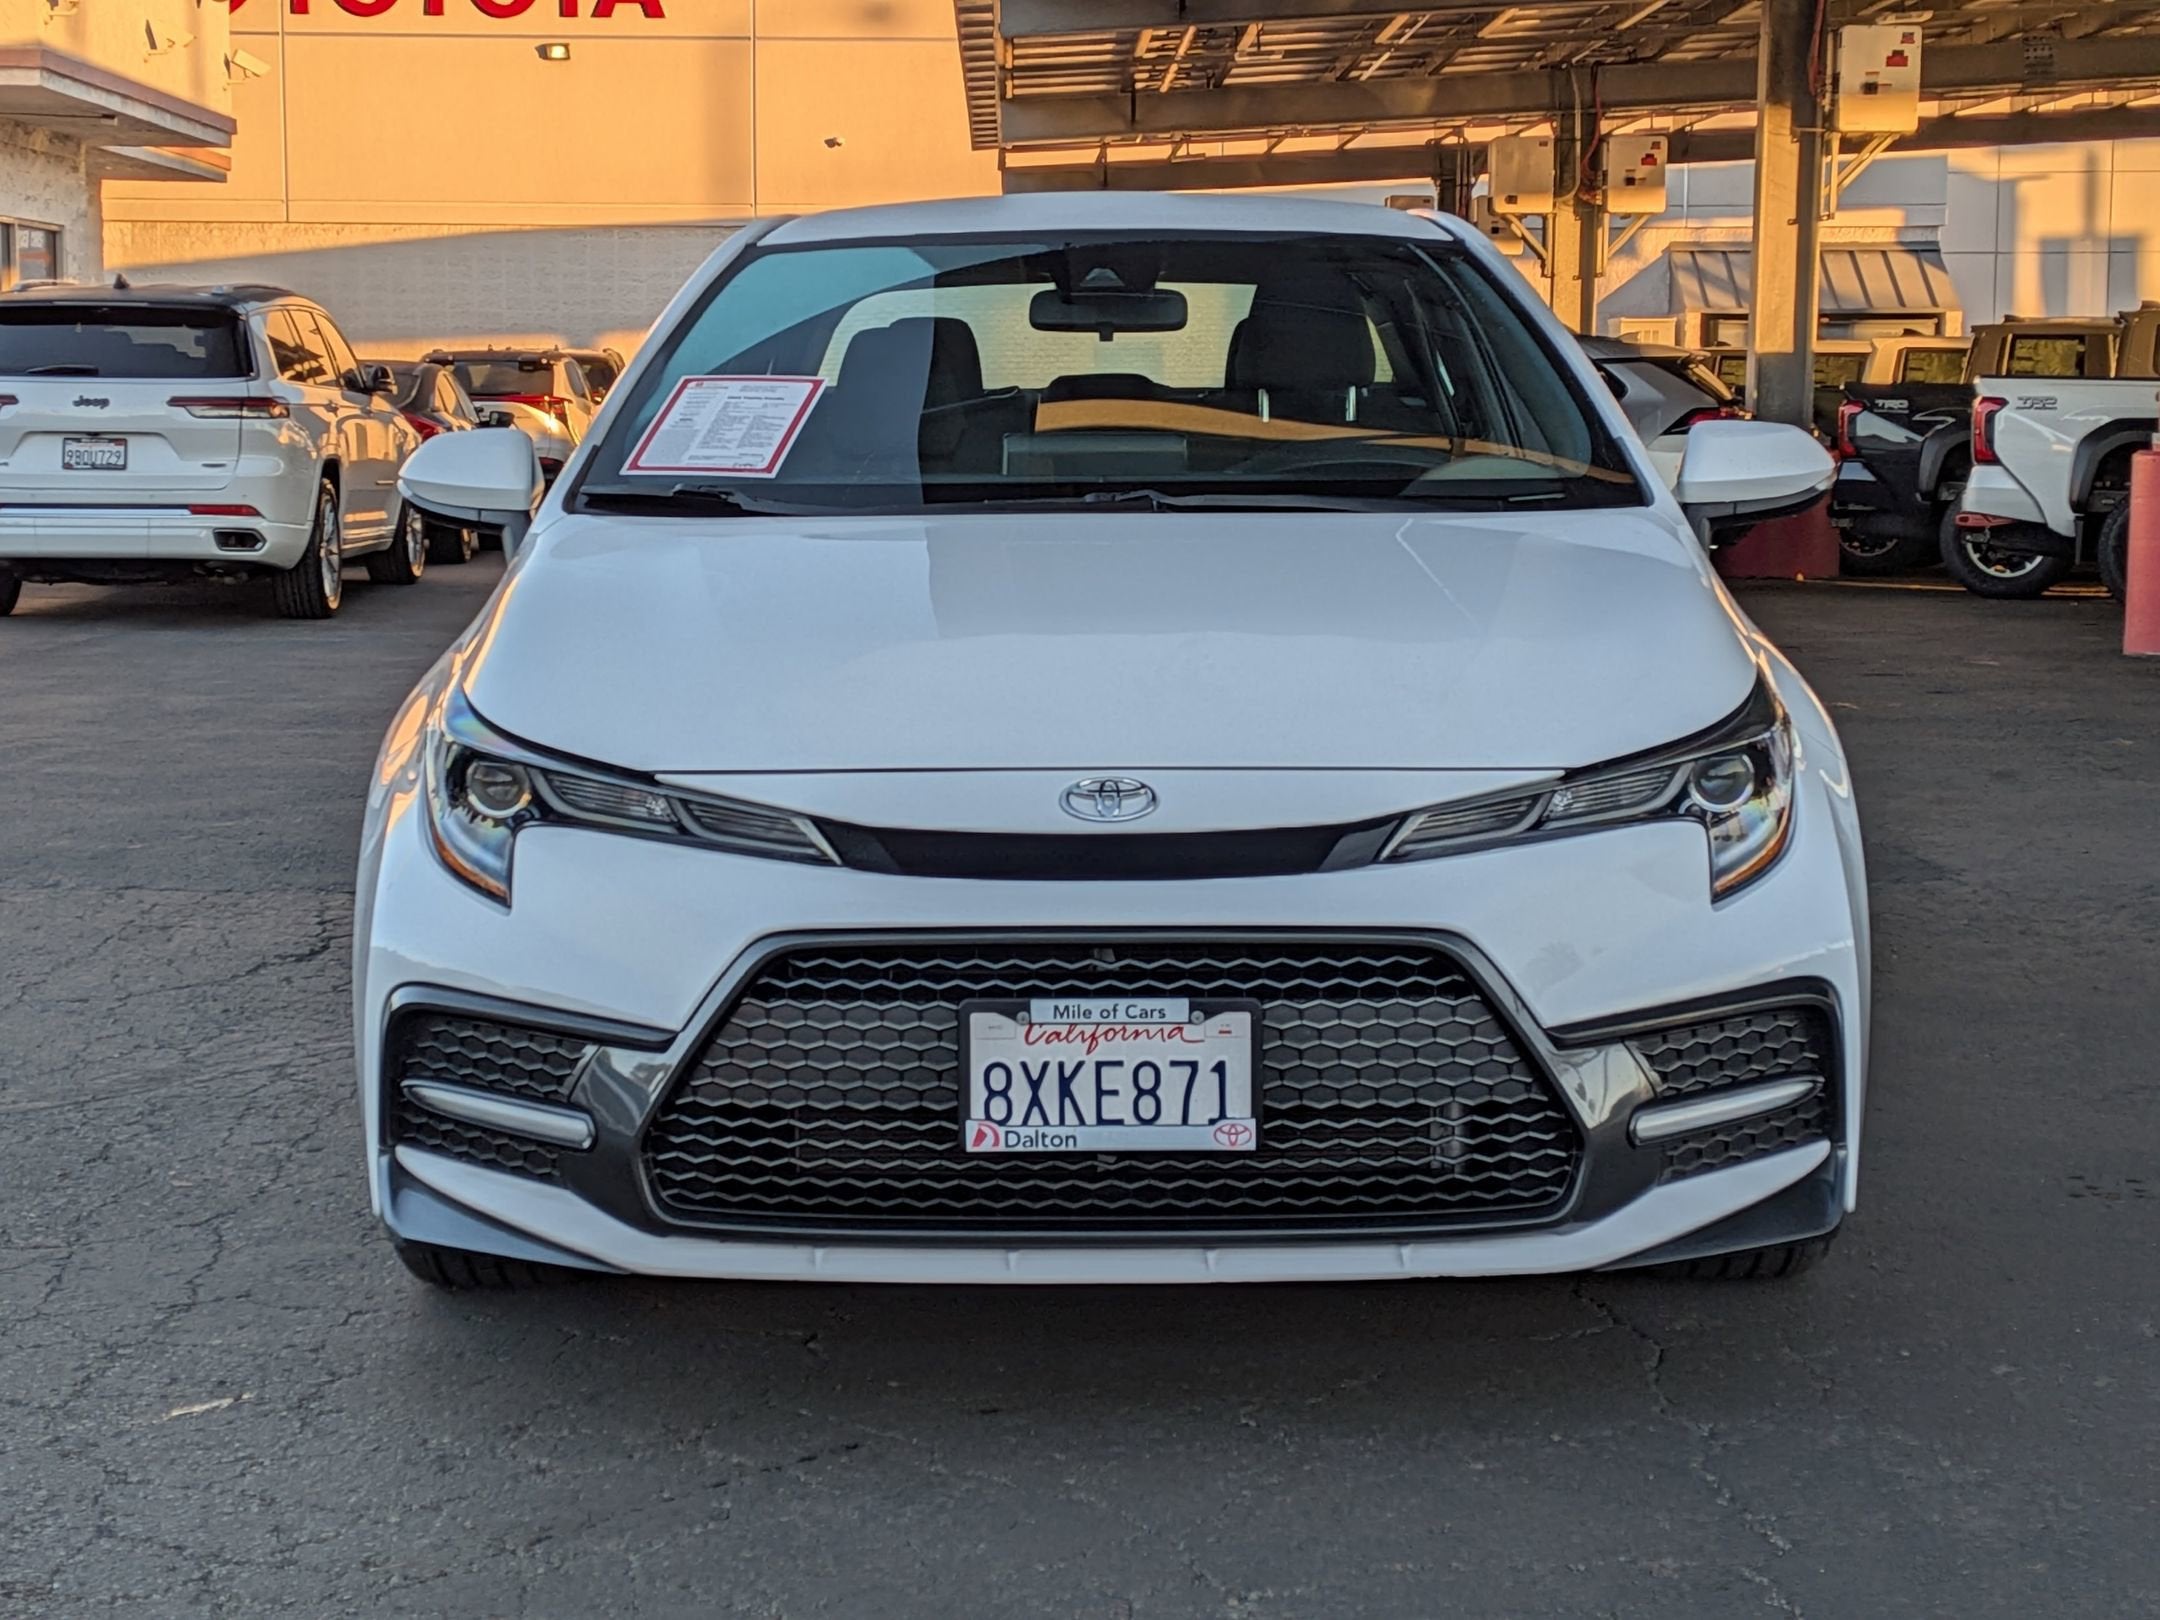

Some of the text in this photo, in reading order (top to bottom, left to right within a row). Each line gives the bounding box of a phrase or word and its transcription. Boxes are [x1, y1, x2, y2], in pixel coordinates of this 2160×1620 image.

[72, 395, 110, 410] Jeep
[1874, 399, 1909, 409] TRD
[1053, 1004, 1167, 1020] Mile of Cars
[1024, 1023, 1205, 1056] California
[983, 1060, 1227, 1126] 8XKE871
[1005, 1130, 1078, 1149] Dalton
